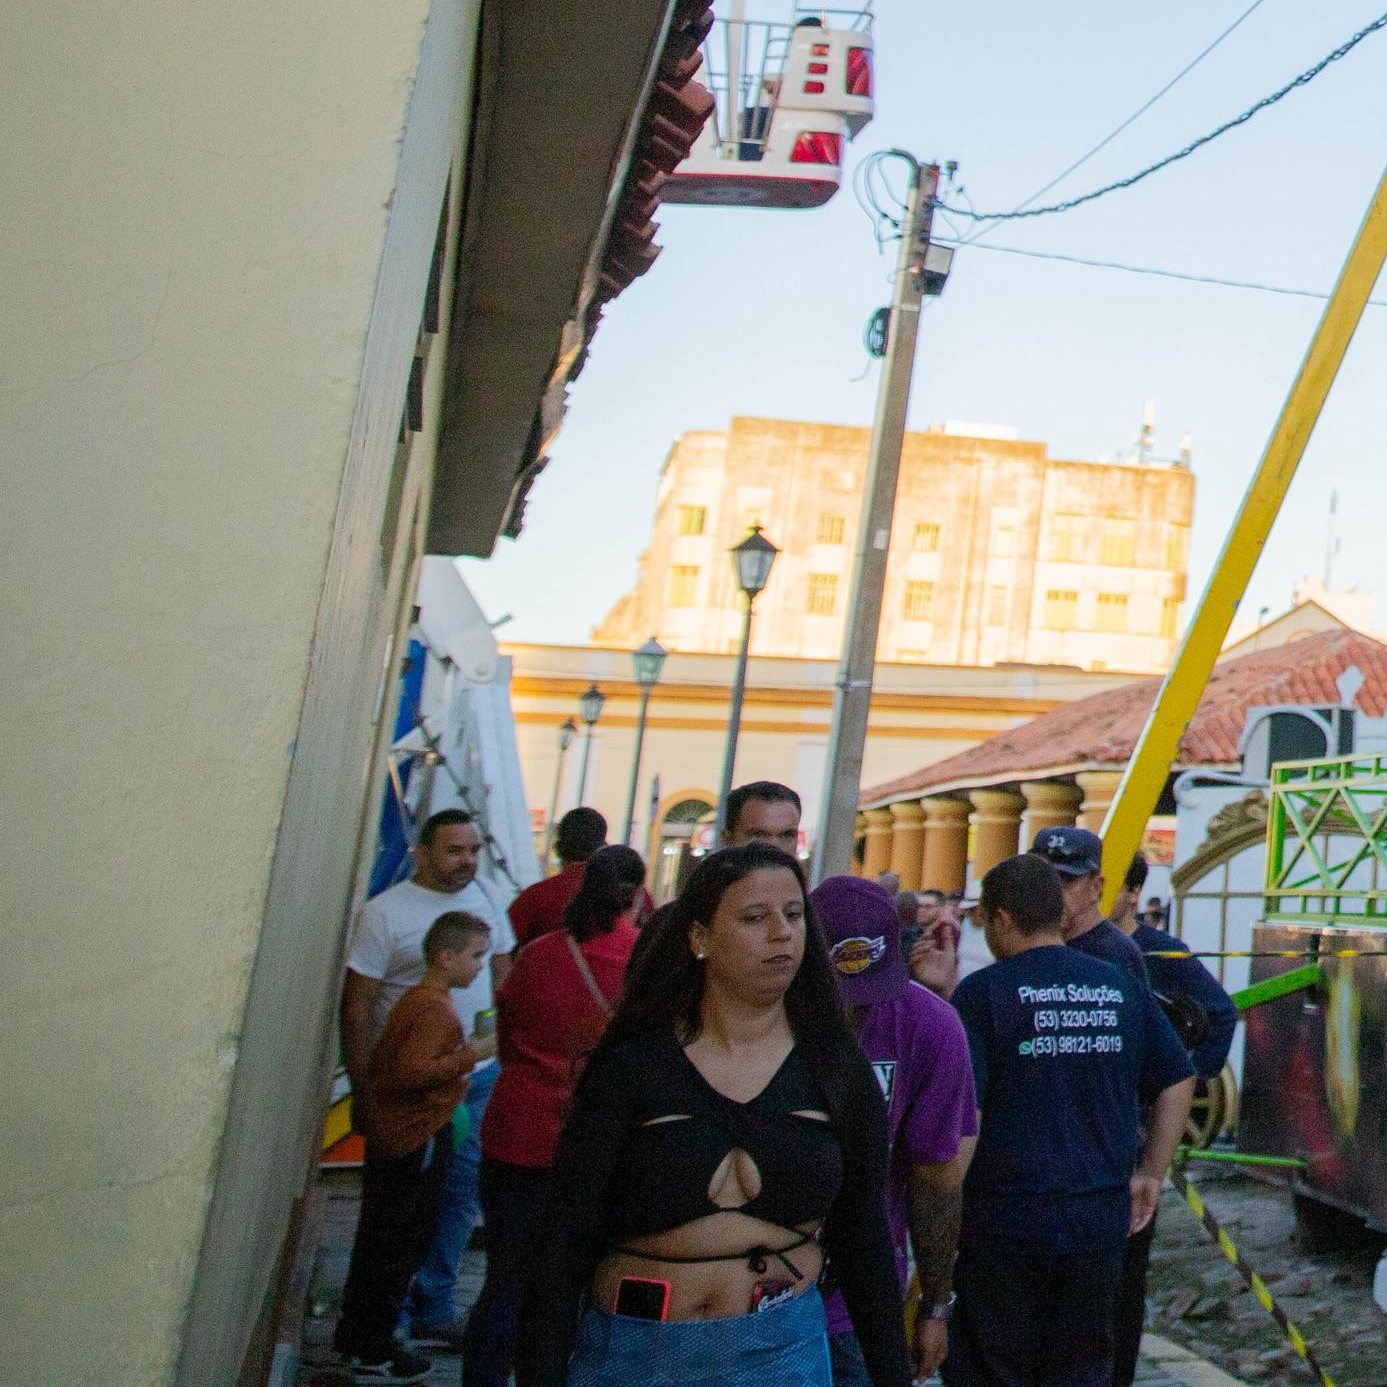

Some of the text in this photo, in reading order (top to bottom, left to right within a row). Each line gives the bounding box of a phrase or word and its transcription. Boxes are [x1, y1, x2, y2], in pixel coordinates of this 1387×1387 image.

[1018, 983, 1124, 1006] Phenix Soluções
[1034, 1010, 1059, 1032] (53)
[1032, 1035, 1123, 1058] (53) 98121-6019
